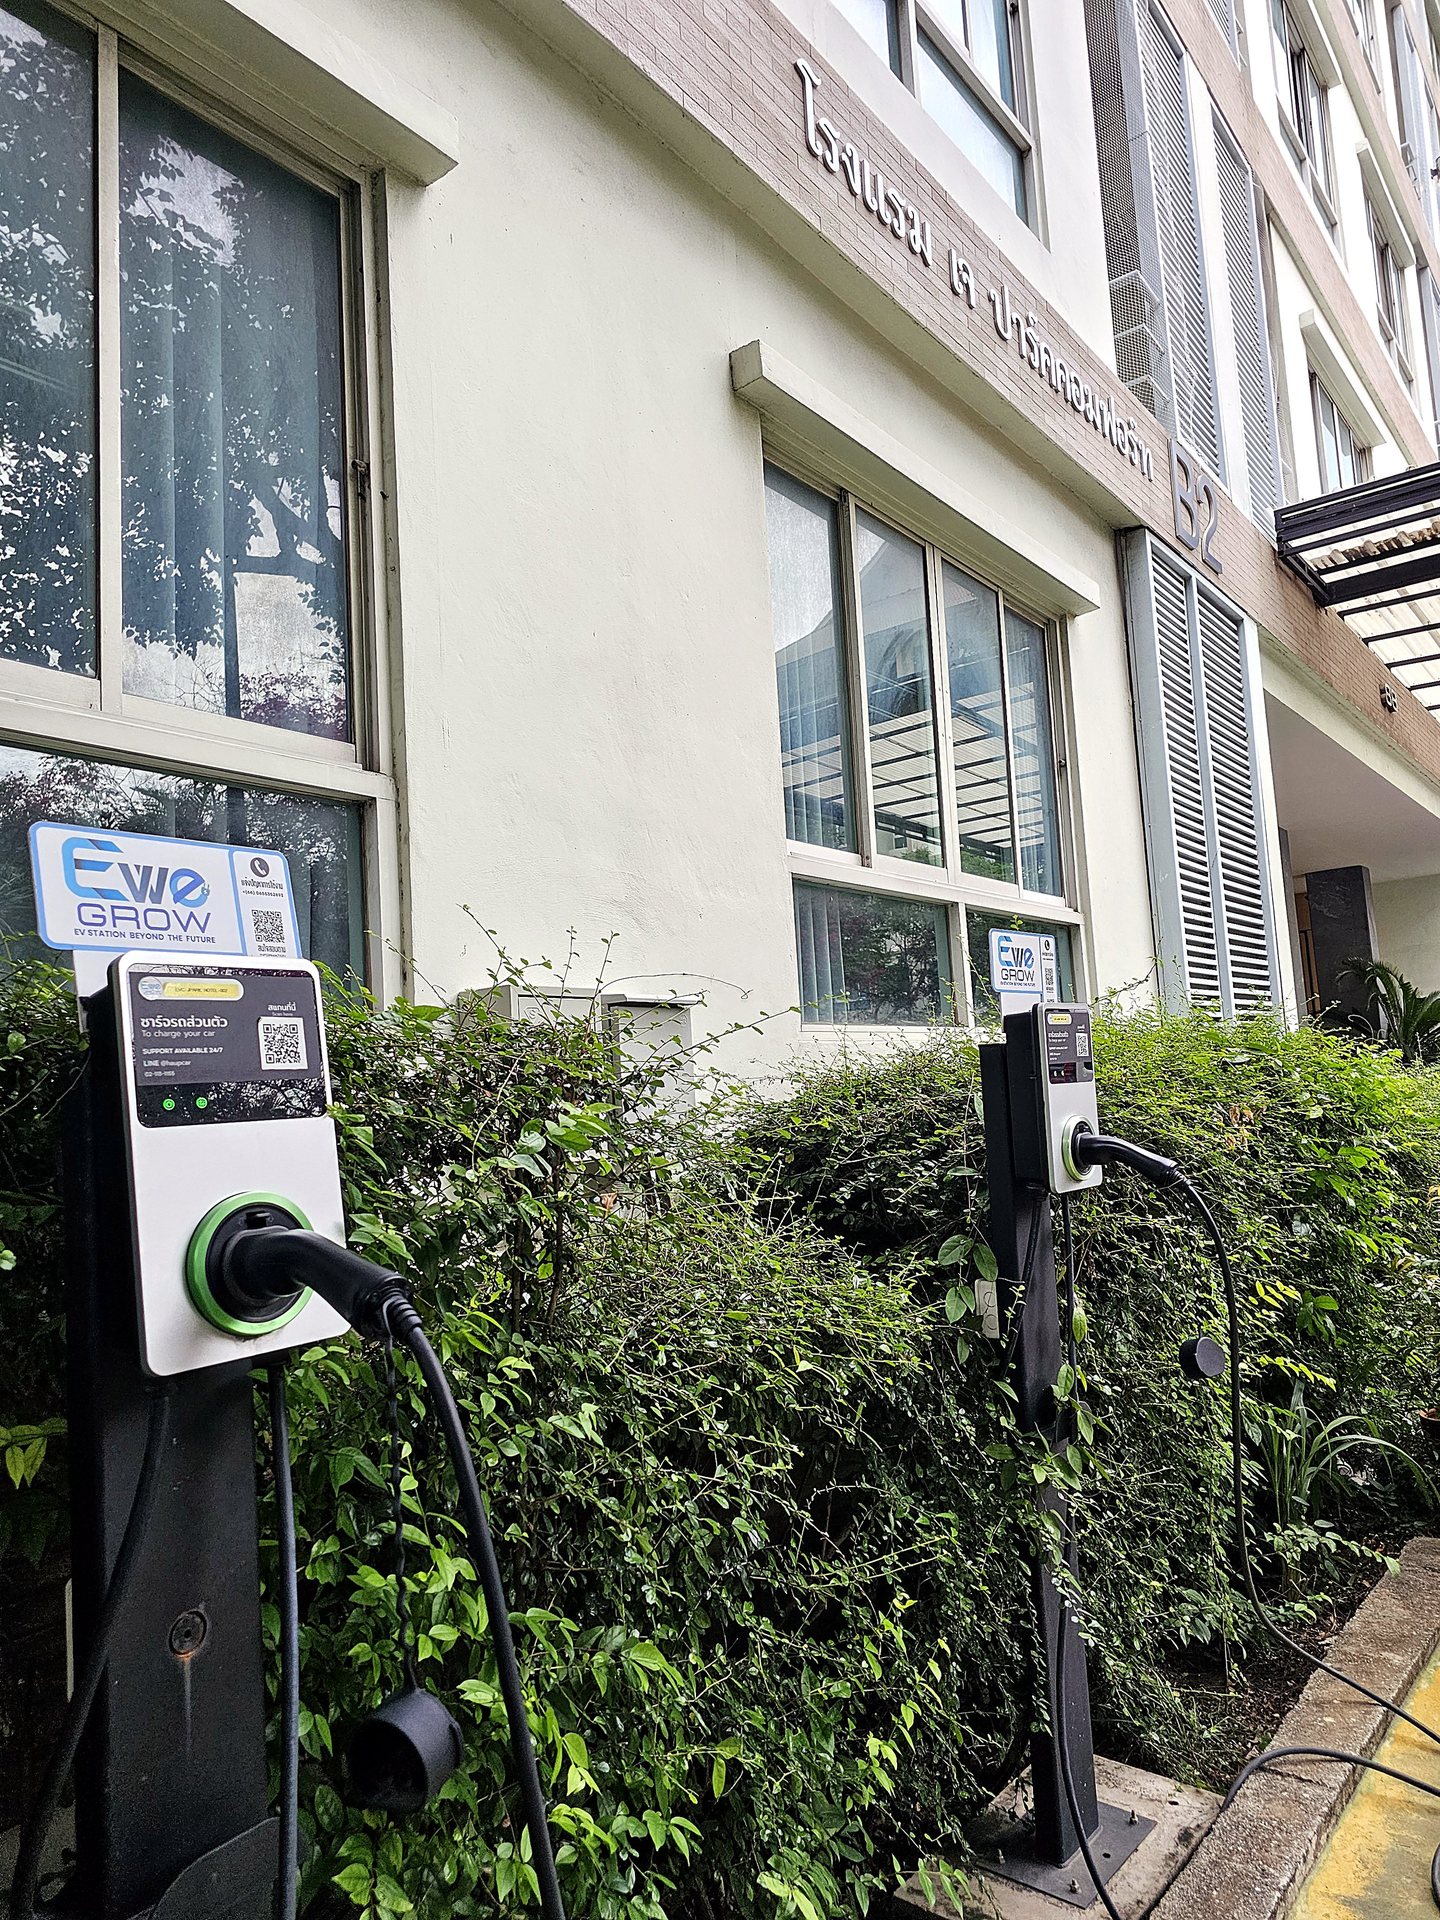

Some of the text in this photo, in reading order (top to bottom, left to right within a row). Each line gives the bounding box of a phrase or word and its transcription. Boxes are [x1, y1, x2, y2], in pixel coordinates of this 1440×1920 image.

[794, 58, 1153, 482] โรงแรม เจ ปาร์คคอมฟอร์ท
[1167, 438, 1222, 575] B2
[77, 902, 212, 934] GROW
[74, 928, 216, 944] EV STATION BEYOND THE FUTURE
[1001, 968, 1035, 982] GROW
[140, 1014, 228, 1028] ชาร์จรถส่วนตัว
[142, 1030, 152, 1038] To
[153, 1030, 181, 1039] charge
[183, 1031, 201, 1039] your
[142, 1047, 173, 1055] SUPPORT
[208, 1046, 224, 1054] 24/7
[143, 1059, 160, 1067] LINE
